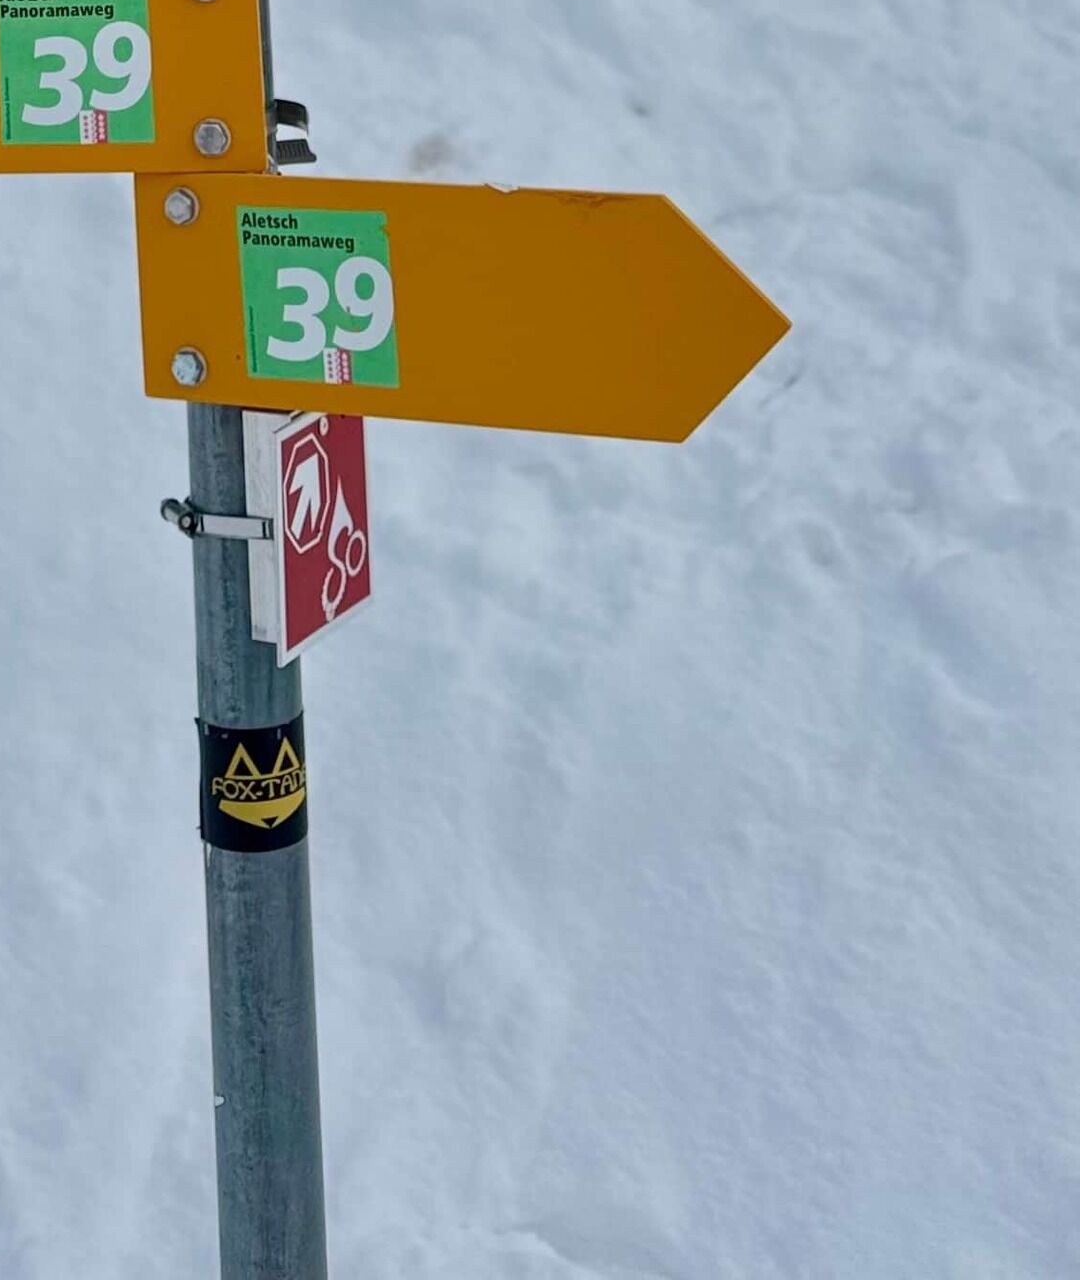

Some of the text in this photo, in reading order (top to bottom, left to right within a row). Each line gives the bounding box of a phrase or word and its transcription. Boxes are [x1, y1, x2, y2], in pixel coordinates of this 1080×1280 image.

[0, 3, 114, 20] Panoramaweg
[21, 20, 152, 127] 39
[241, 213, 298, 230] Aletsch
[242, 230, 355, 253] Panoramaweg
[266, 256, 395, 362] 39
